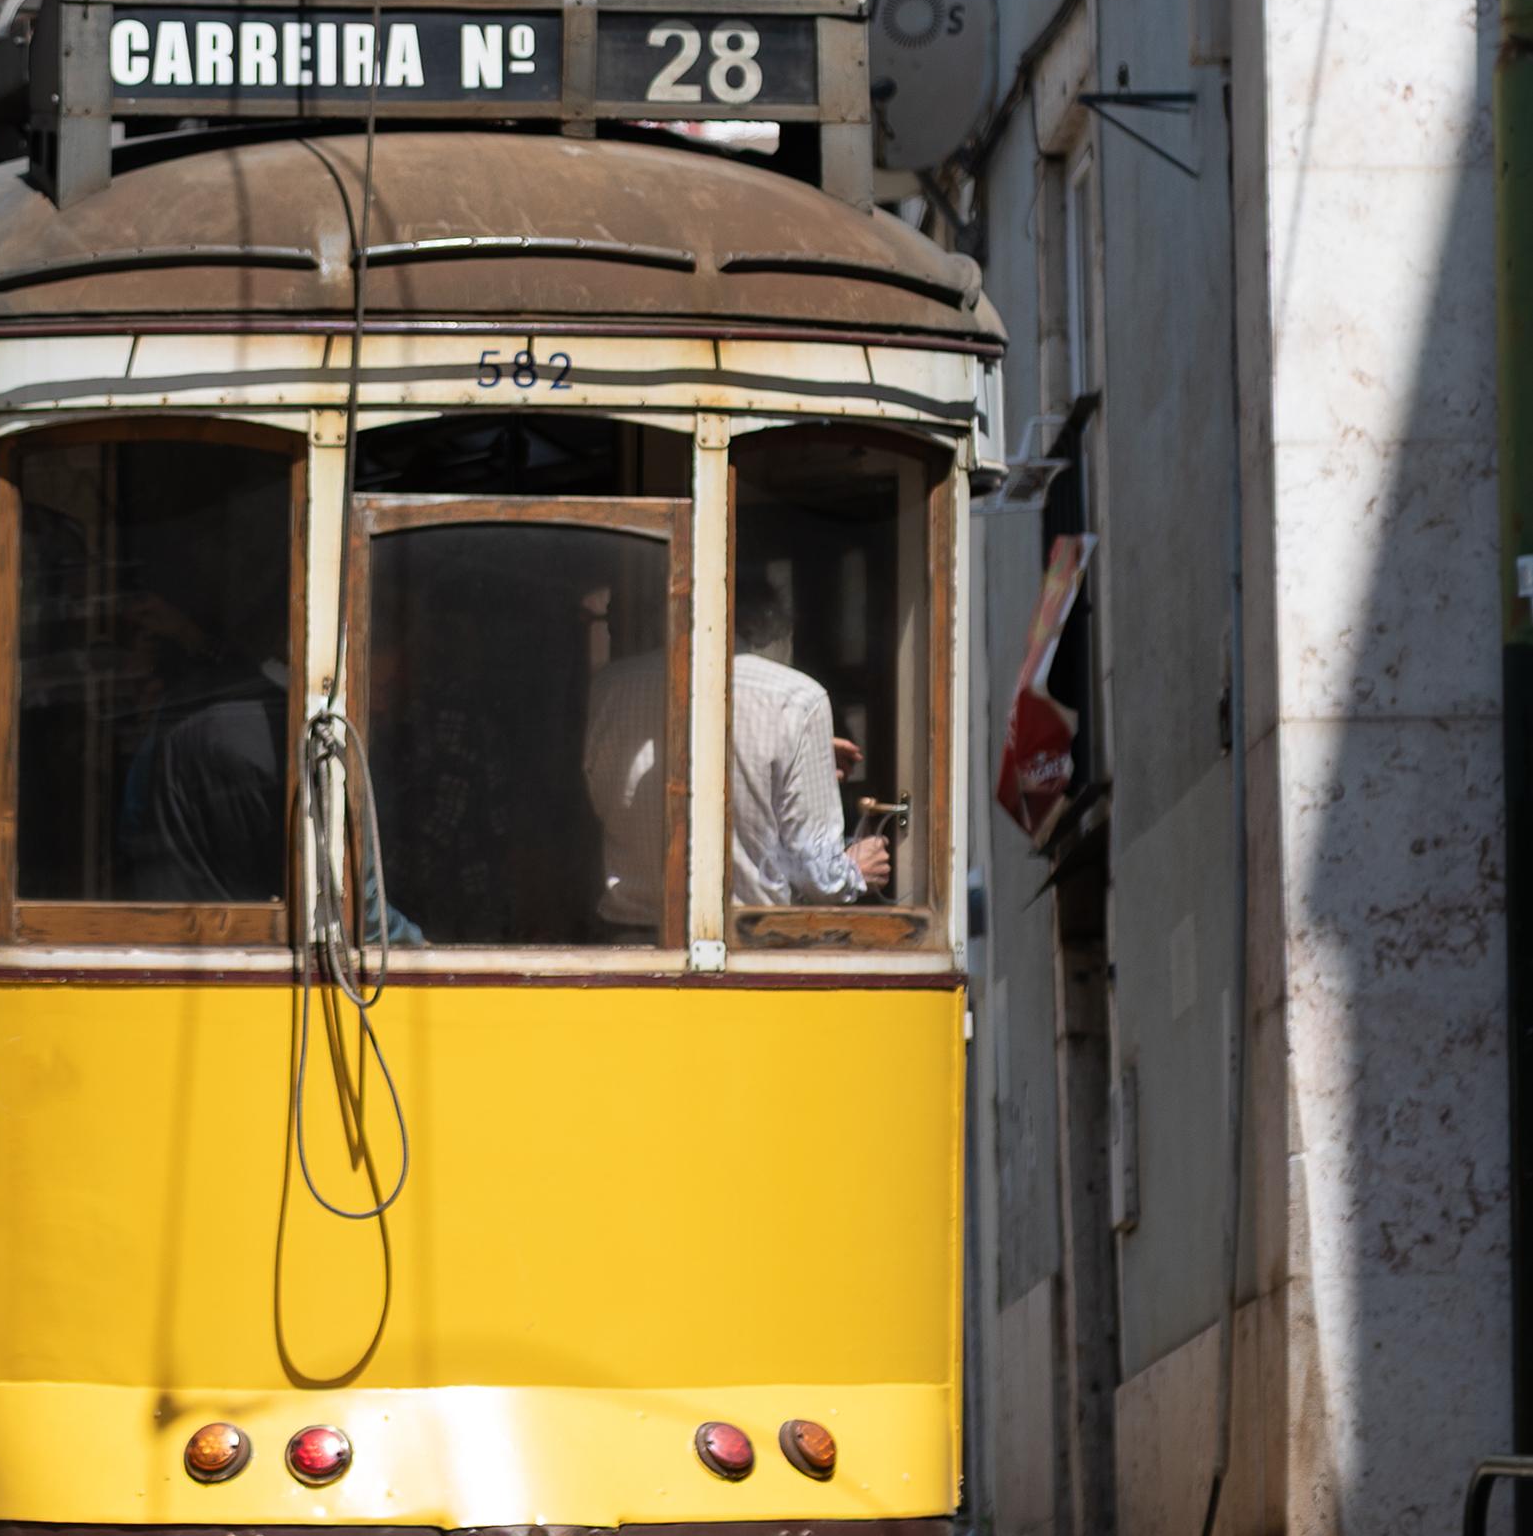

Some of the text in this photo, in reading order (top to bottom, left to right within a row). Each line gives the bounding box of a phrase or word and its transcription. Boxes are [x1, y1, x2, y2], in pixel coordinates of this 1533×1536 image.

[109, 18, 763, 104] CARREIRA Nº 28
[476, 349, 573, 390] 582
